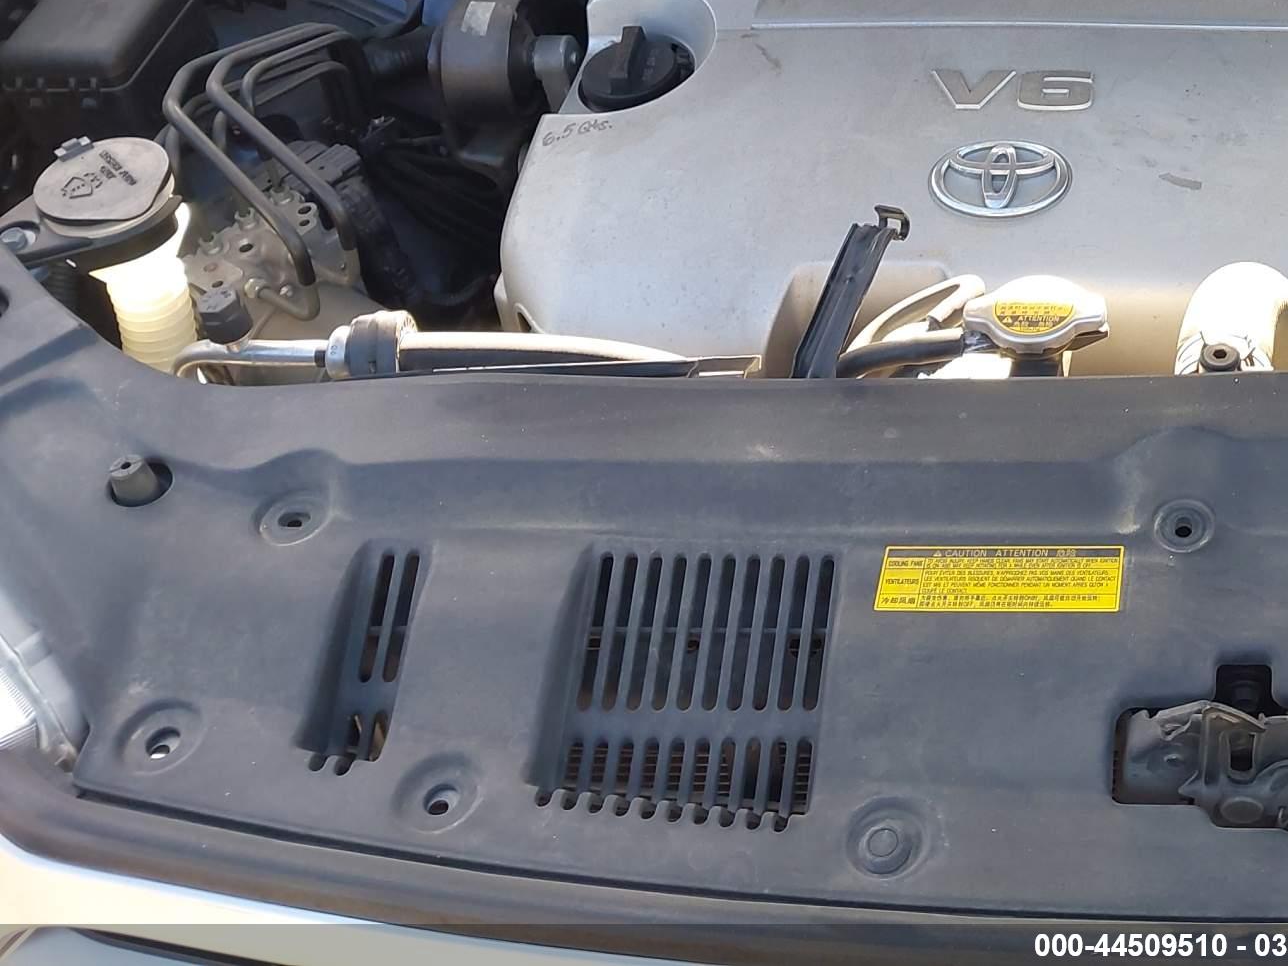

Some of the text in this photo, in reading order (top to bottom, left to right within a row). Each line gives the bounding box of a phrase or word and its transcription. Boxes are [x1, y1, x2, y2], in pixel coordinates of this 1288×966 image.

[930, 67, 1094, 111] V6
[542, 122, 577, 147] 6.5
[945, 549, 1049, 557] CAUTION ATTENTION
